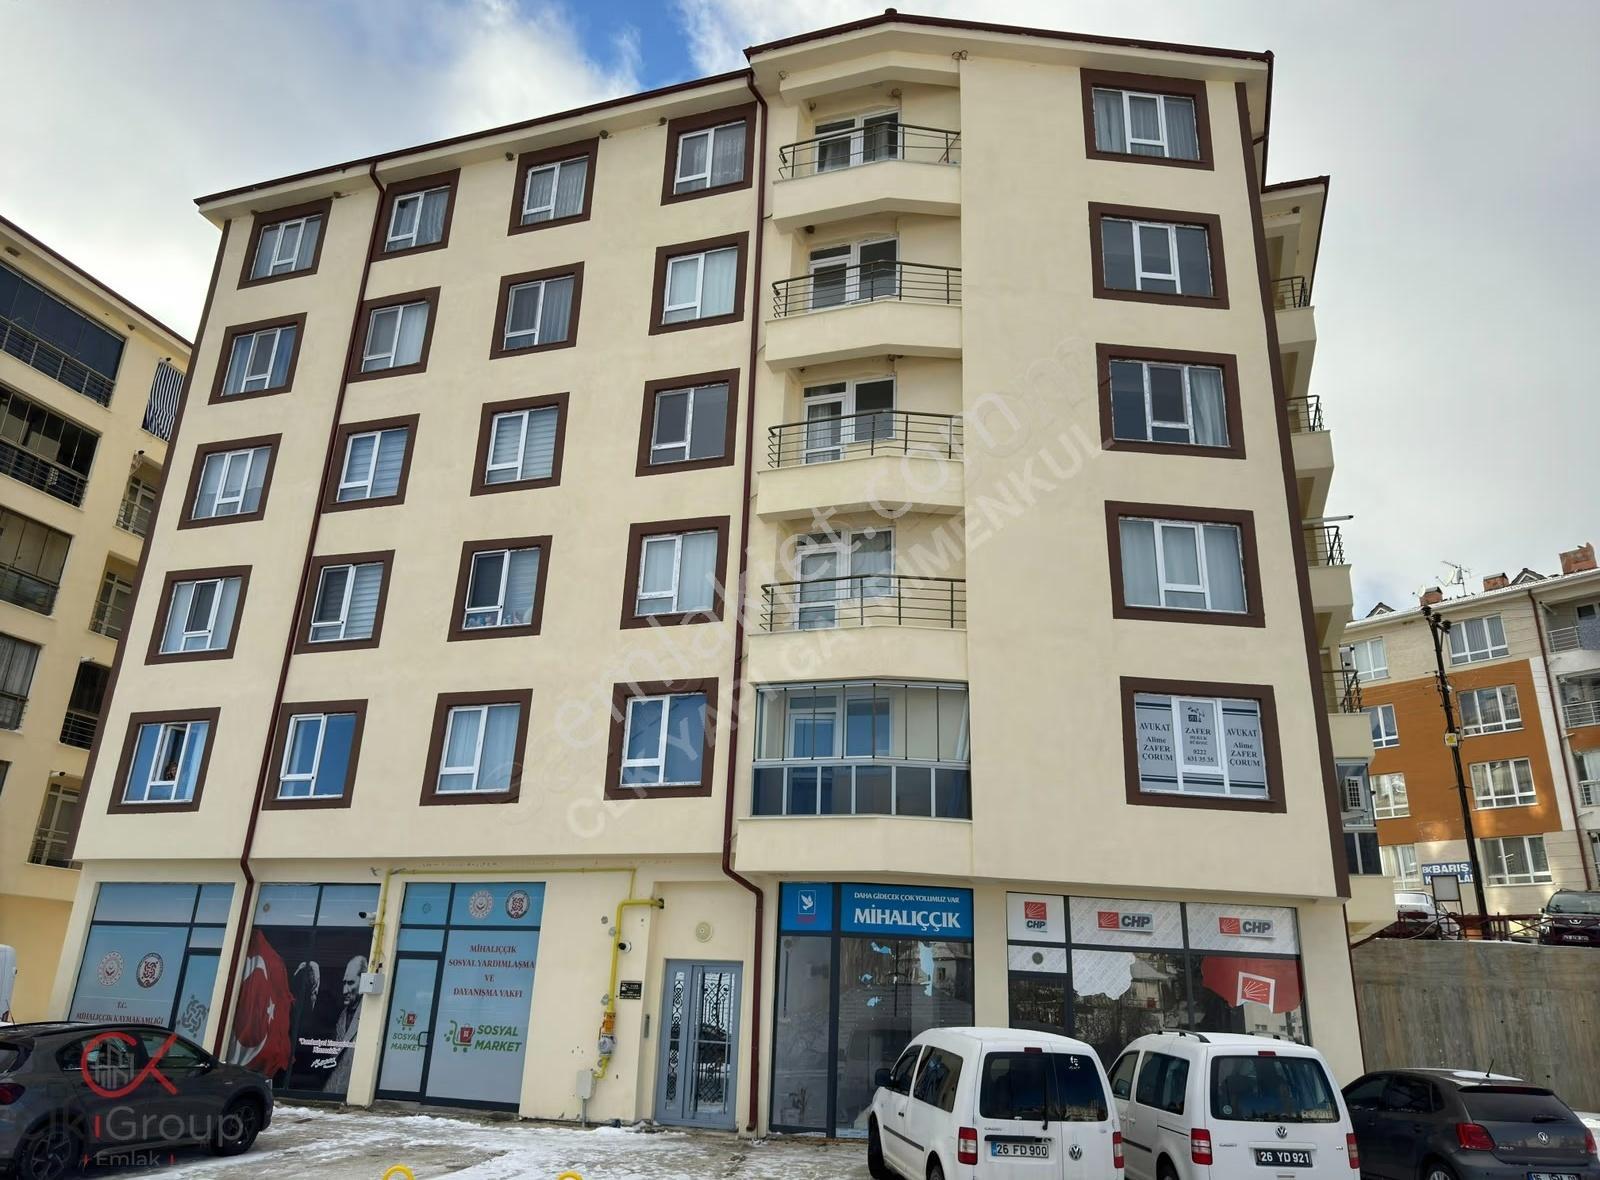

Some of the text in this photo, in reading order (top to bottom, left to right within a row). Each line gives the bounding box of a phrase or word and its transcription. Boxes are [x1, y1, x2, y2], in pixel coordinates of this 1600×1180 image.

[1139, 722, 1171, 732] AVUKAT
[1184, 727, 1212, 735] ZAFER
[1226, 727, 1257, 737] AVUKAT
[1143, 744, 1171, 753] ZAFER
[1142, 753, 1173, 761] ÇORUM
[1231, 750, 1258, 758] ZAFER
[1229, 759, 1260, 767] ÇORUM
[900, 894, 914, 902] ÇOK
[915, 895, 946, 903] YOLUMUZ
[854, 904, 961, 932] MİHALIÇÇIK
[1121, 915, 1150, 928] CHP
[1026, 920, 1046, 929] CHP
[1242, 921, 1271, 934] CHP
[448, 959, 535, 970] SOSYAL YARDIMLAŞMA
[484, 974, 495, 982] VE
[453, 987, 498, 997] DAYANIŞMA
[477, 1024, 519, 1037] SOSYAL
[391, 1043, 421, 1052] MARKET
[474, 1040, 522, 1052] MARKET
[997, 1144, 1047, 1156] 26 FD 900
[1260, 1152, 1309, 1163] 26 YD 921
